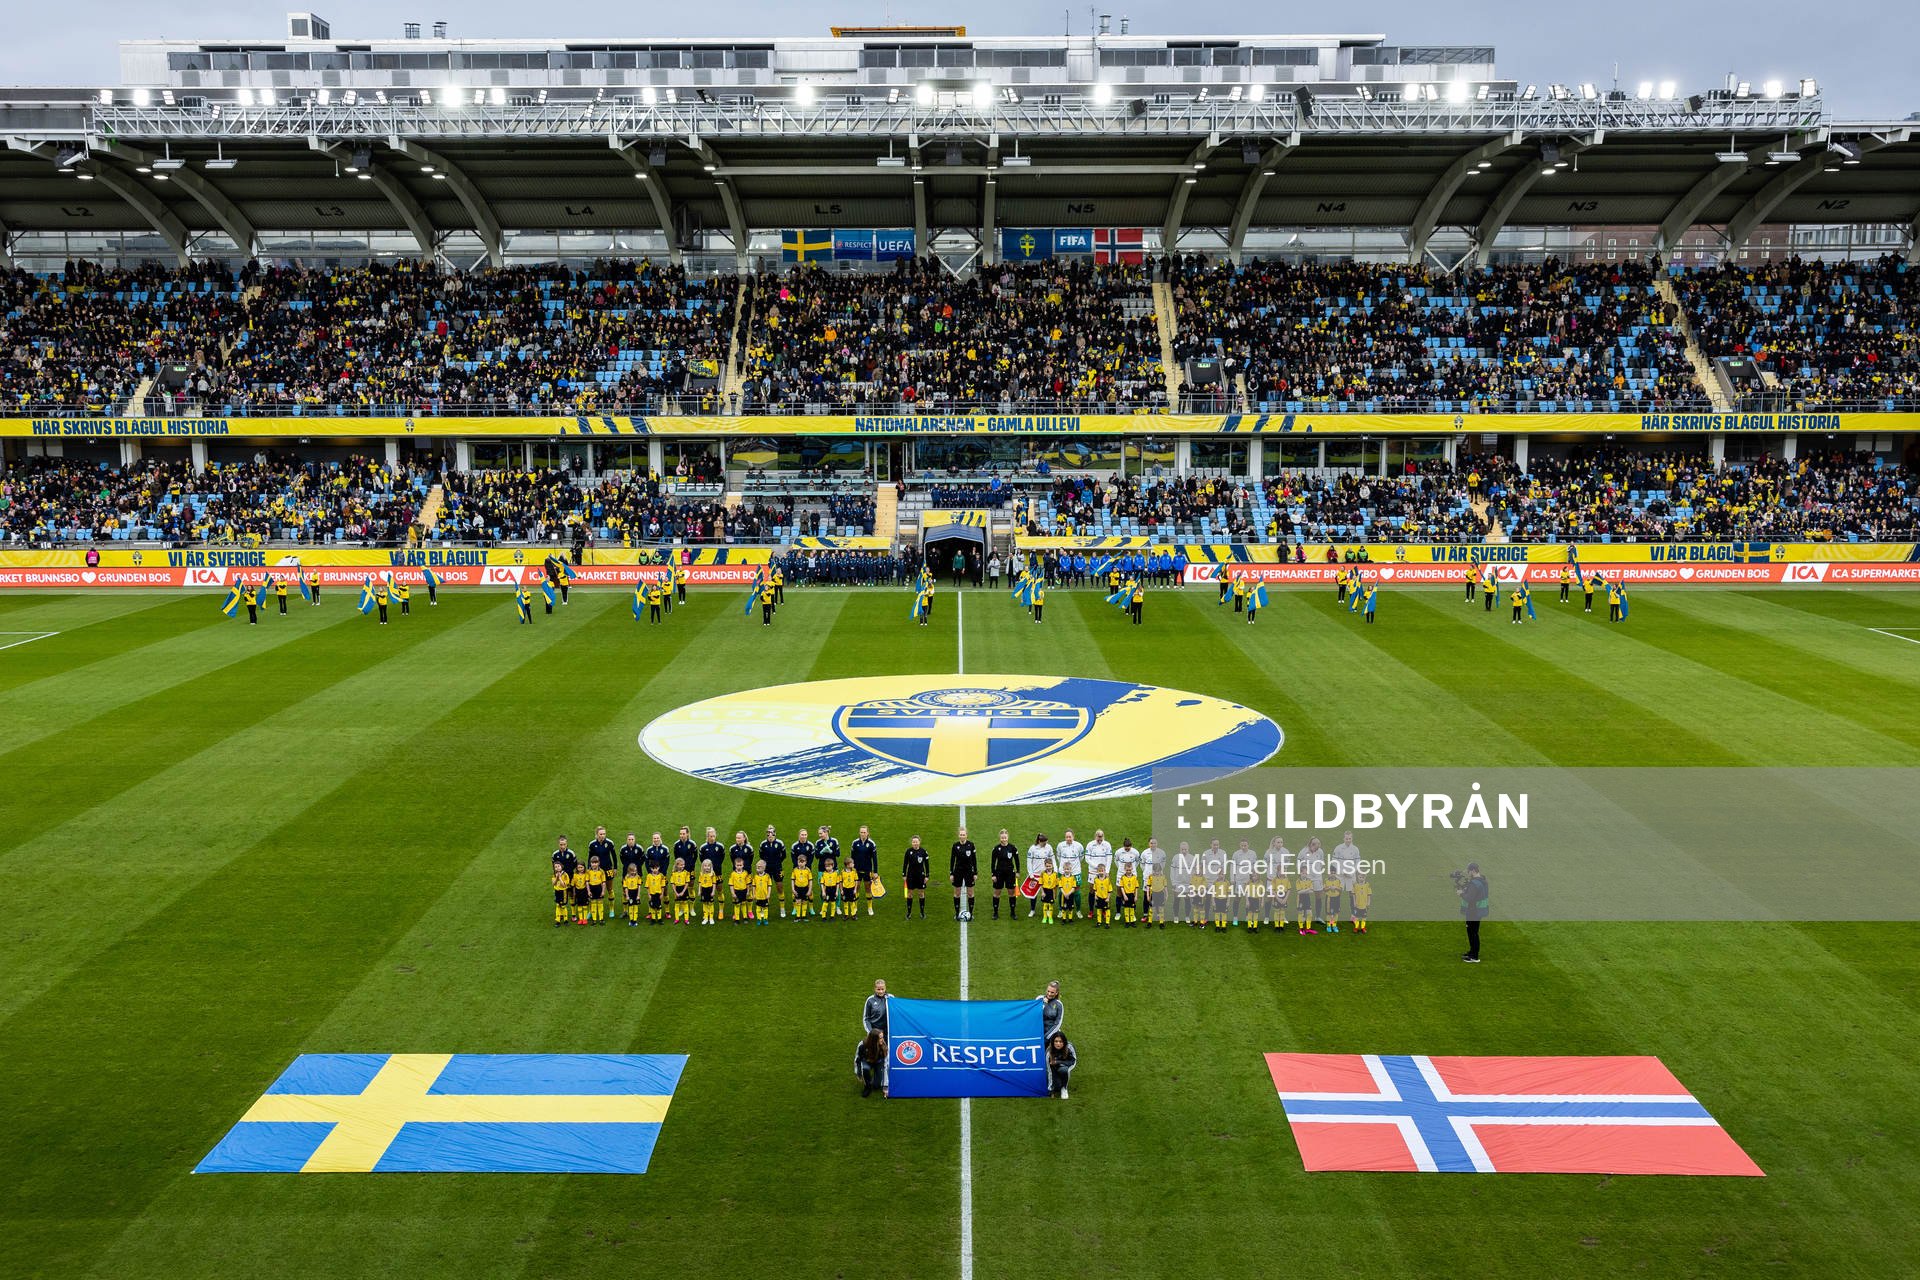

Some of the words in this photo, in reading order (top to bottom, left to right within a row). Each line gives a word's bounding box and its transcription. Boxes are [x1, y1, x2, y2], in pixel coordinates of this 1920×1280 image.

[814, 204, 842, 215] L5
[1067, 203, 1096, 214] N5
[1317, 202, 1346, 213] N4
[1568, 201, 1598, 212] N3
[1816, 199, 1850, 210] N2
[61, 207, 94, 217] L2
[315, 206, 345, 217] L3
[565, 205, 594, 216] L4
[844, 241, 872, 249] RESPECT
[879, 240, 912, 251] UEFA
[1060, 235, 1086, 246] FIFA
[32, 420, 61, 435] HÄR
[63, 420, 112, 435] SKRIVS
[115, 420, 165, 435] BLÅGUL
[167, 420, 229, 435] HISTORIA
[855, 417, 975, 432] NATIONALARENAN
[987, 417, 1035, 432] GAMLA
[1036, 417, 1080, 432] ULLEVI
[1641, 415, 1669, 430] HÄR
[1672, 415, 1722, 430] SKRIVS
[1724, 415, 1774, 430] BLÅGUL
[1778, 415, 1840, 430] HISTORIA
[168, 551, 183, 566] VI
[186, 551, 205, 566] ÄR
[208, 551, 266, 566] SVERIGE
[389, 550, 405, 566] V
[407, 550, 426, 566] ÄR
[429, 550, 488, 566] BLÅGULT
[1431, 546, 1445, 562] VI
[1448, 546, 1467, 562] ÄR
[1471, 546, 1528, 562] SVERIGE
[1650, 546, 1664, 561] VI
[1667, 546, 1687, 561] ÄR
[1690, 546, 1734, 561] BLÅGU
[25, 573, 80, 583] BRUNNSBO
[98, 573, 147, 582] GRUNDEN
[149, 573, 171, 582] BOIS
[192, 569, 220, 584] ICA
[395, 571, 444, 581] GRUNN
[446, 571, 468, 581] BOIS
[489, 568, 517, 583] ICA
[692, 571, 740, 581] GRUNDEN
[1251, 569, 1322, 579] SUPERMARKET
[1396, 569, 1445, 579] GRUNDEN
[1531, 569, 1548, 579] ICA
[1623, 569, 1677, 579] BRUNNSBO
[1696, 569, 1746, 579] GRUNDEN
[1747, 569, 1770, 579] BOIS
[1791, 565, 1819, 580] ICA
[1831, 568, 1849, 578] ICA
[933, 1042, 1042, 1065] RESPECT
